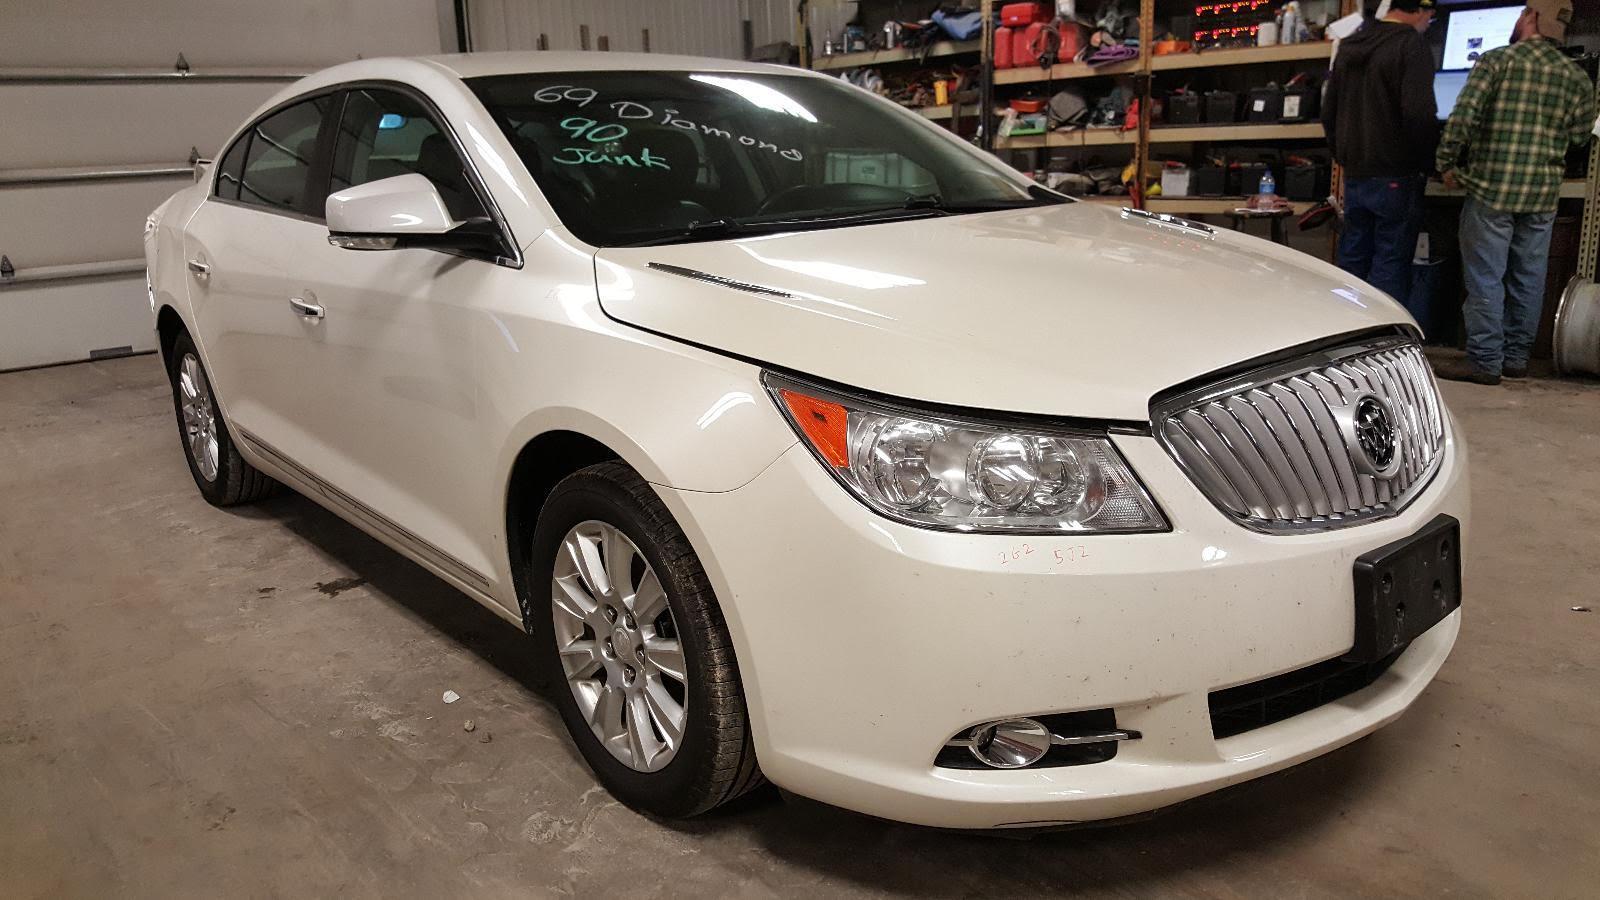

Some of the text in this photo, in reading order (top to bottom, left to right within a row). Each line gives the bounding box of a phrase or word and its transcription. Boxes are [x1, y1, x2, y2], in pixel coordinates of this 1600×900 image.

[534, 85, 803, 161] 69 Diamond
[560, 117, 629, 143] 90
[553, 147, 671, 170] Junk
